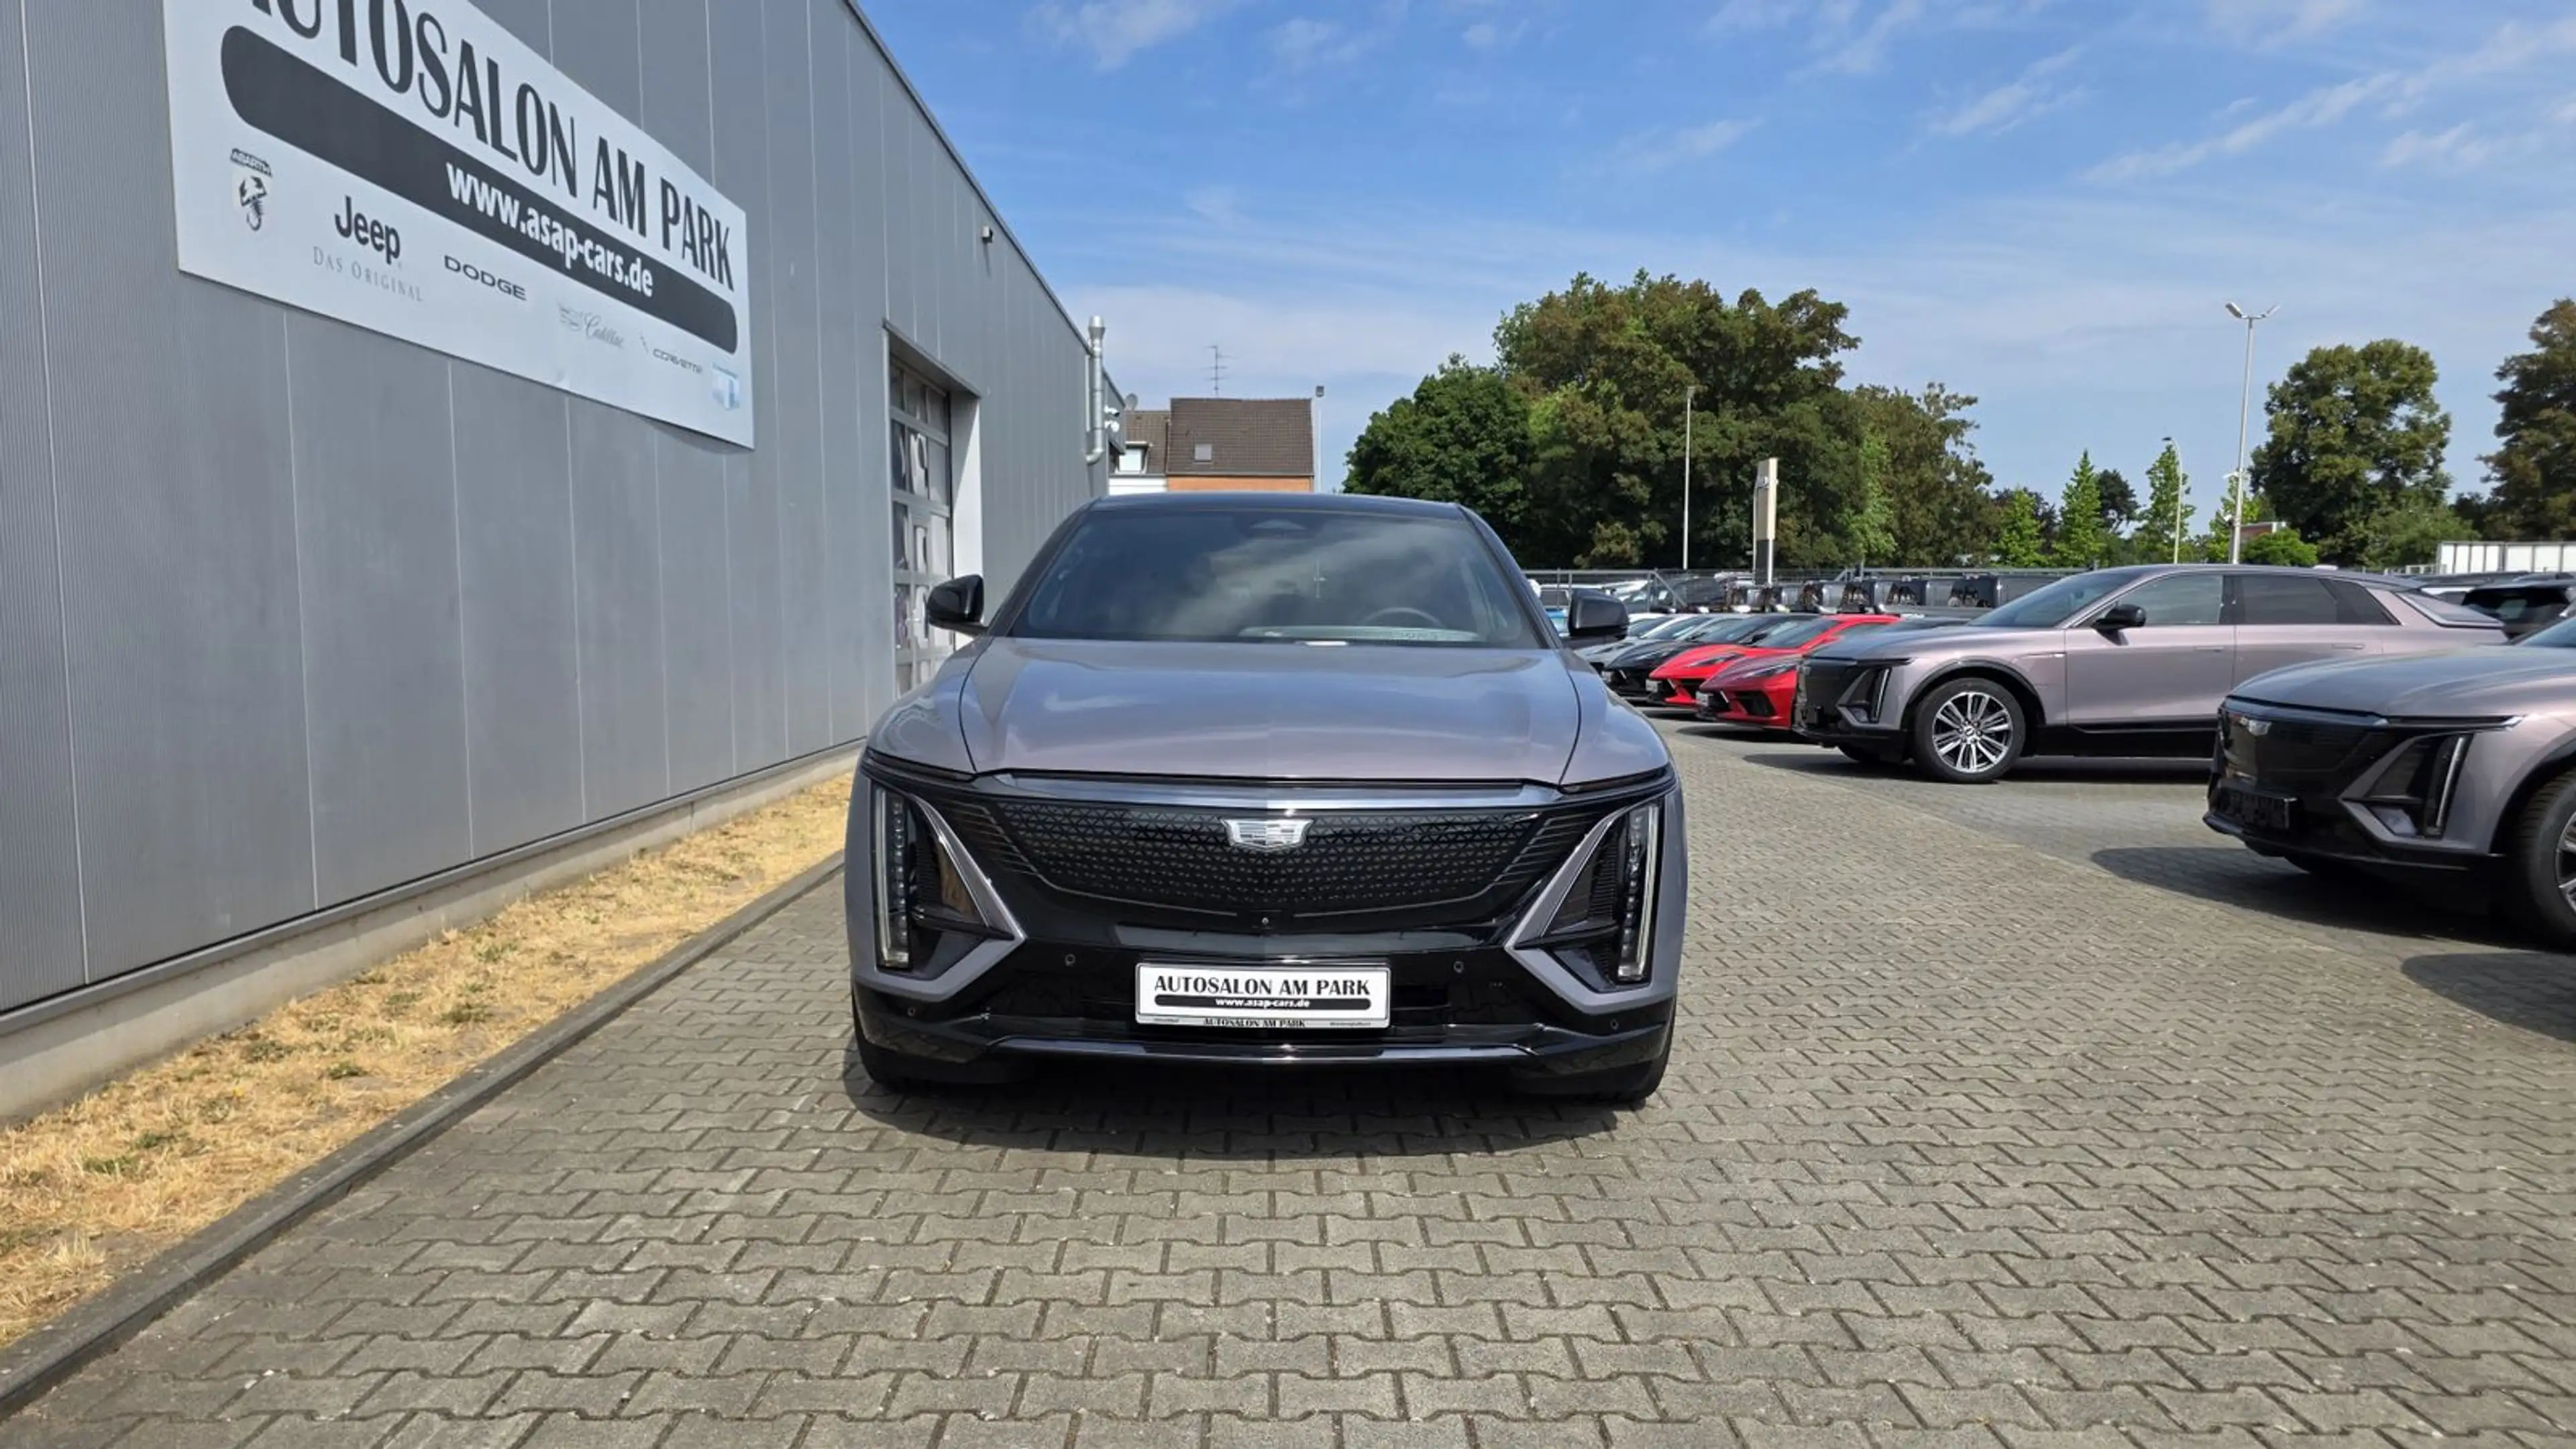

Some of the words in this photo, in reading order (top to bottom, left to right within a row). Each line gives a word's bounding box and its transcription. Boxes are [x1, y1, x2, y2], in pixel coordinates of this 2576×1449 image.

[334, 195, 401, 266] Jeep
[446, 162, 653, 297] www.asap-cars.de
[593, 135, 647, 238] AM
[660, 176, 735, 292] PARK
[443, 254, 528, 301] DODGE
[1154, 975, 1273, 995] AUTOSALON
[1279, 979, 1308, 996] AM
[1316, 979, 1371, 996] PARK
[1215, 998, 1310, 1009] www.asap-cars.de
